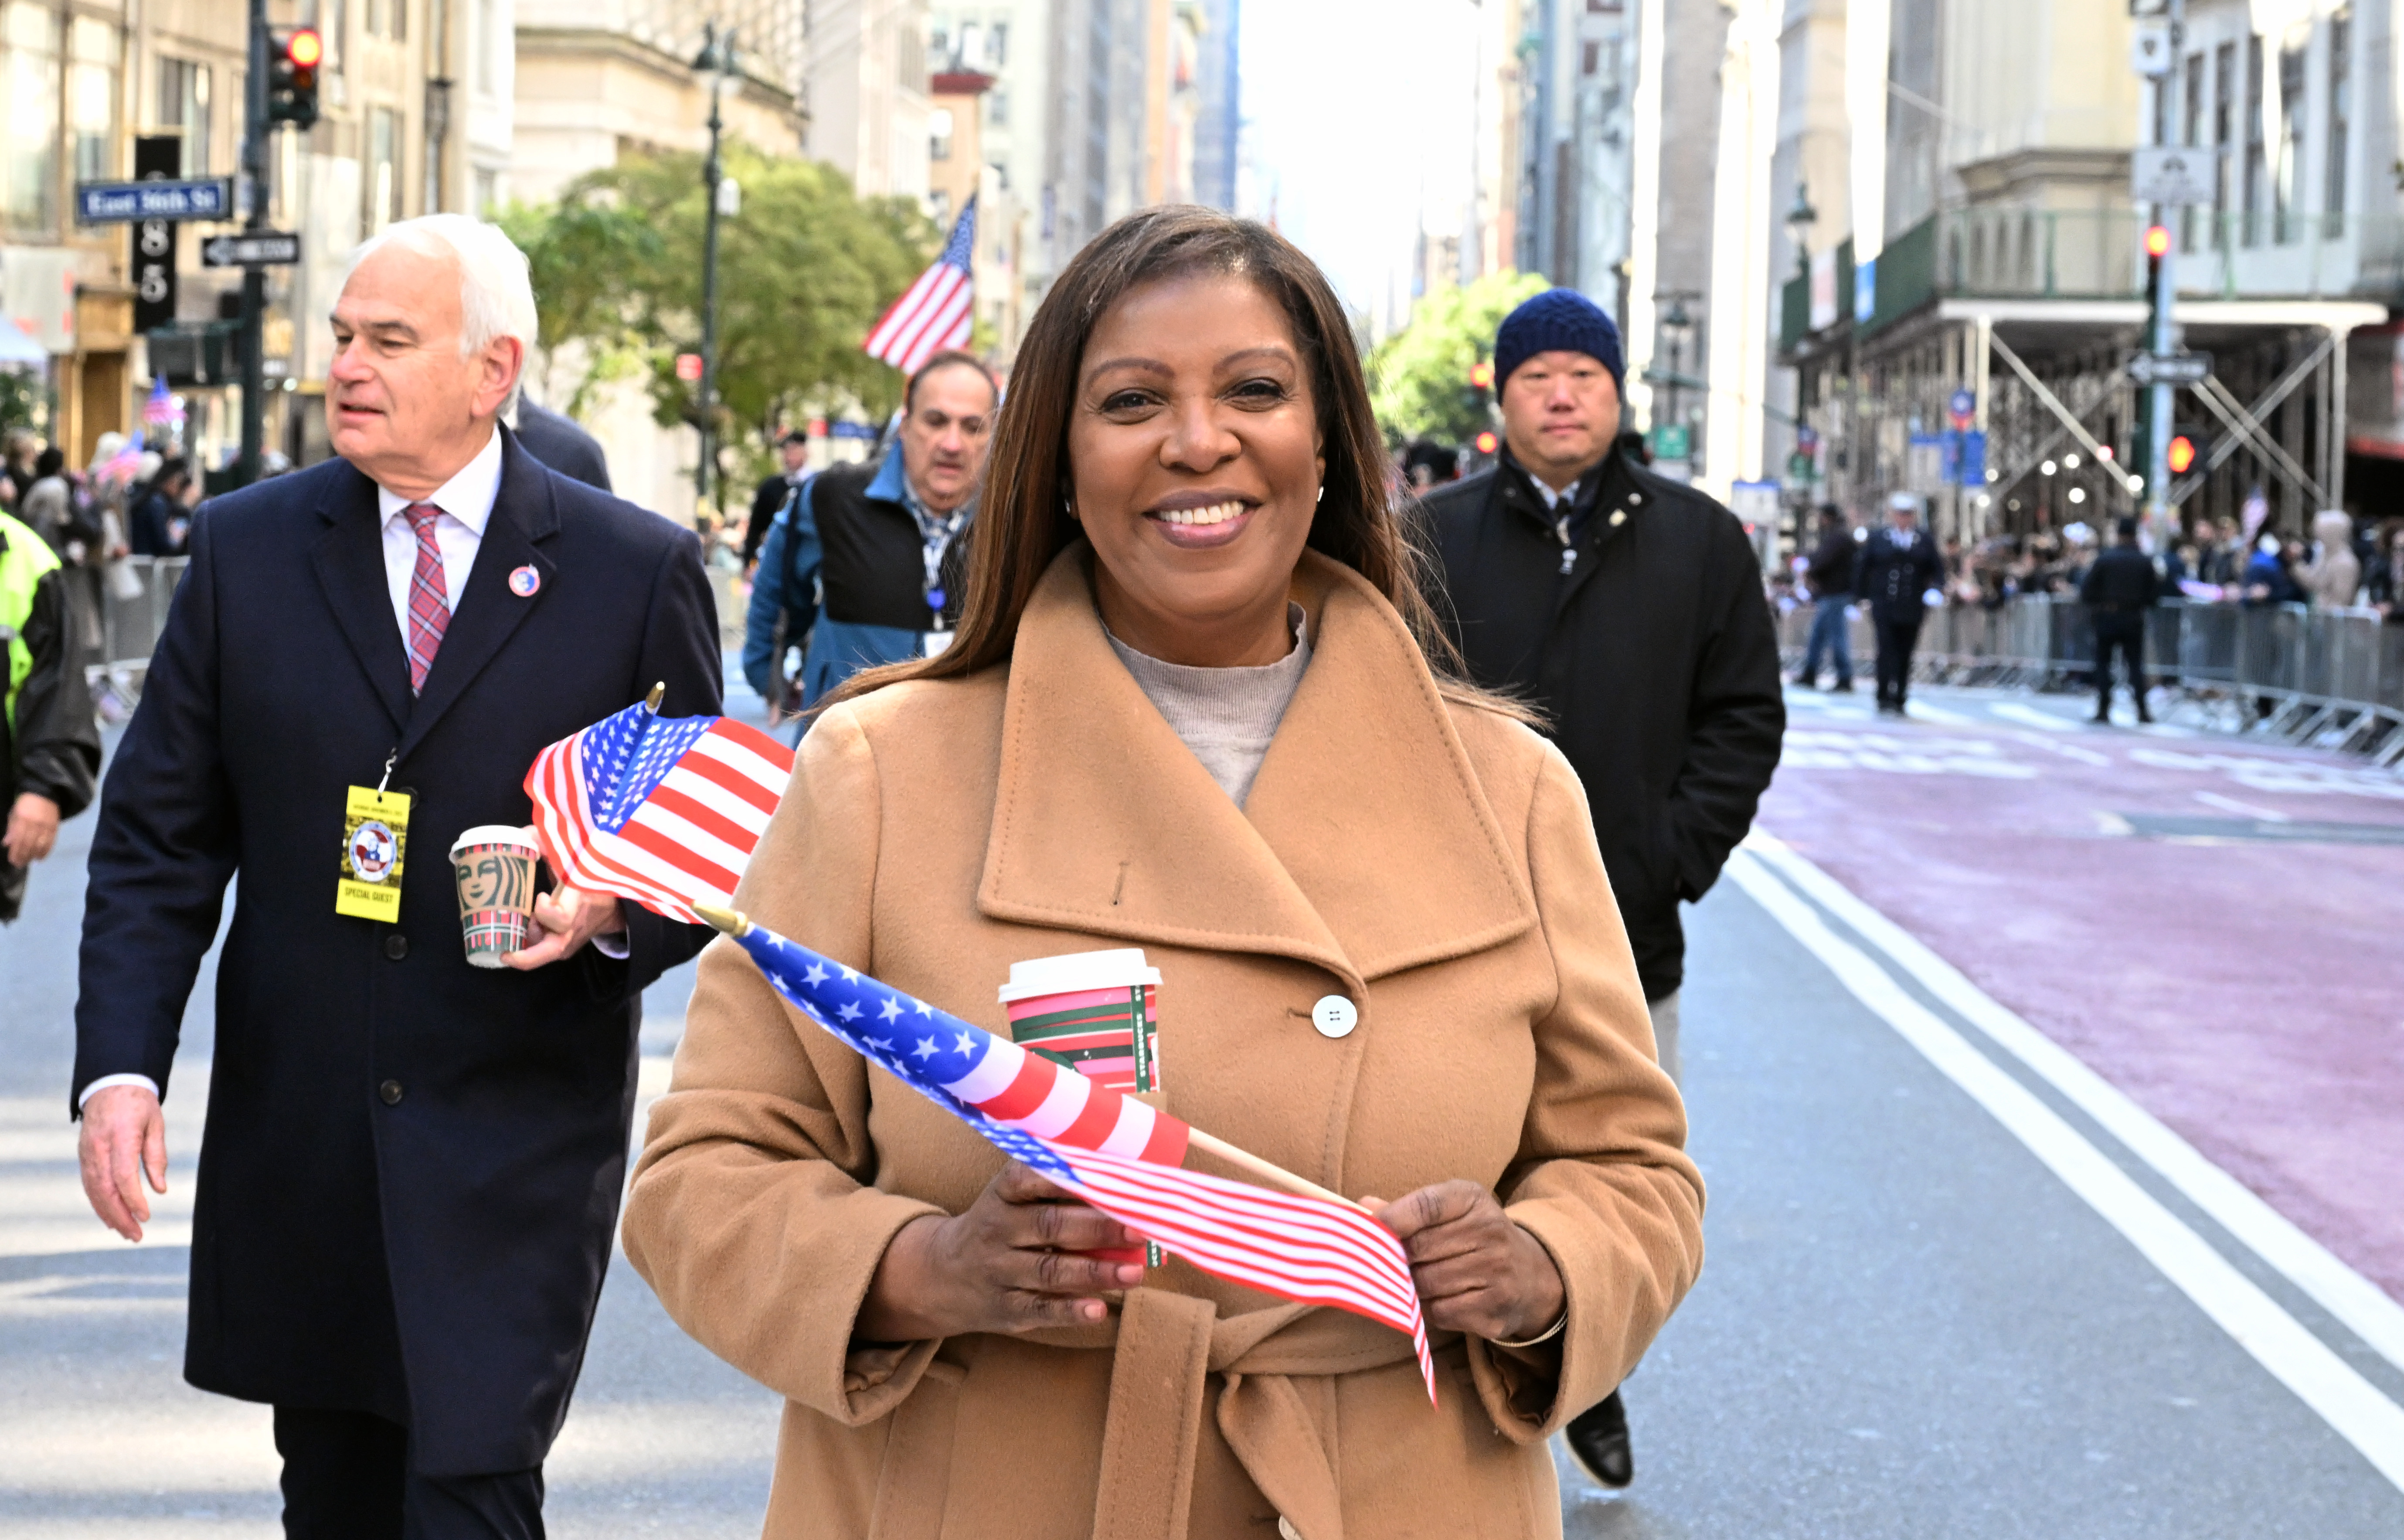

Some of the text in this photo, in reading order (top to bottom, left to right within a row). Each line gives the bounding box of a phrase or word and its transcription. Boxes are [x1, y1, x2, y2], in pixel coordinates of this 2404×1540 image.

[344, 887, 393, 904] SPECIAL GUEST
[1136, 1013, 1146, 1078] STARBUCKS
